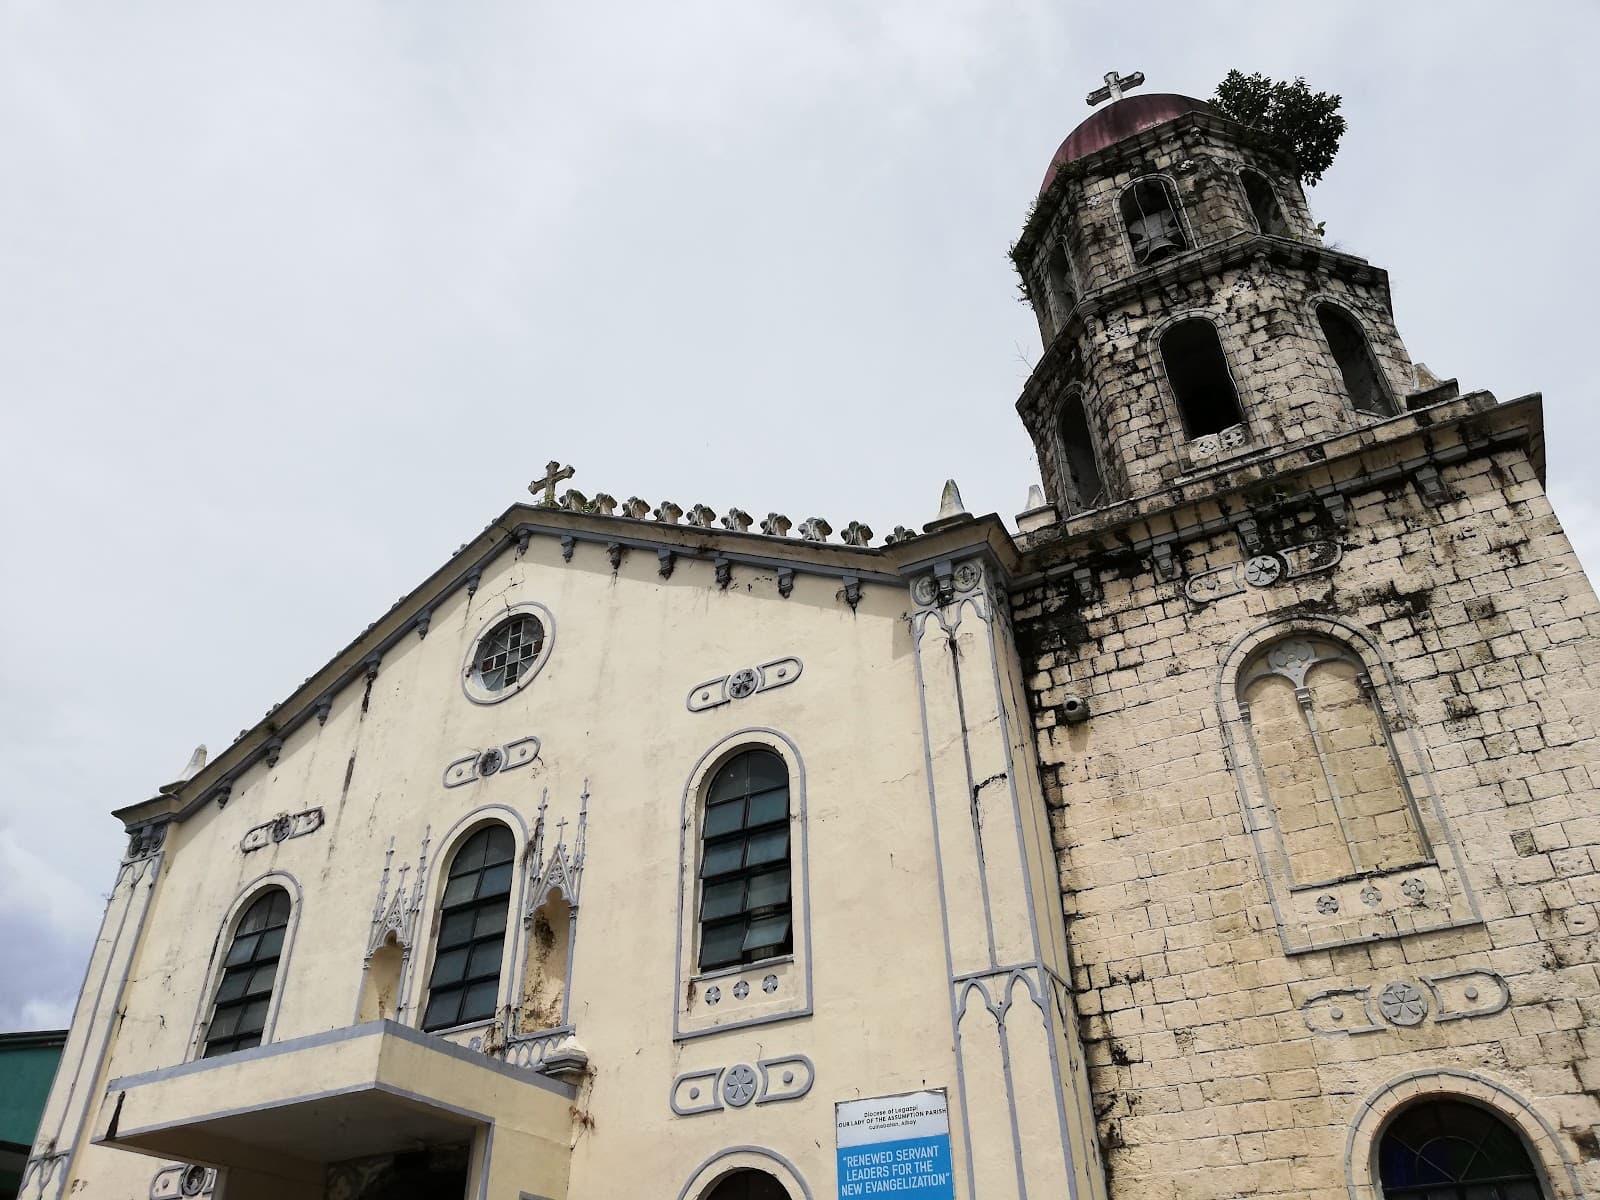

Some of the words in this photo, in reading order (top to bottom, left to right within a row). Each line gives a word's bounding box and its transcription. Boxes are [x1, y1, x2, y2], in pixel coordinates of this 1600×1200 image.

[850, 1119, 865, 1127] LADY
[887, 1111, 924, 1121] ASSUMPTION
[925, 1108, 947, 1117] PARISH
[896, 1145, 939, 1162] SERVANT
[846, 1165, 889, 1182] LEADERS
[892, 1163, 912, 1177] FOR
[914, 1160, 934, 1174] THE
[841, 1183, 863, 1197] NEW
